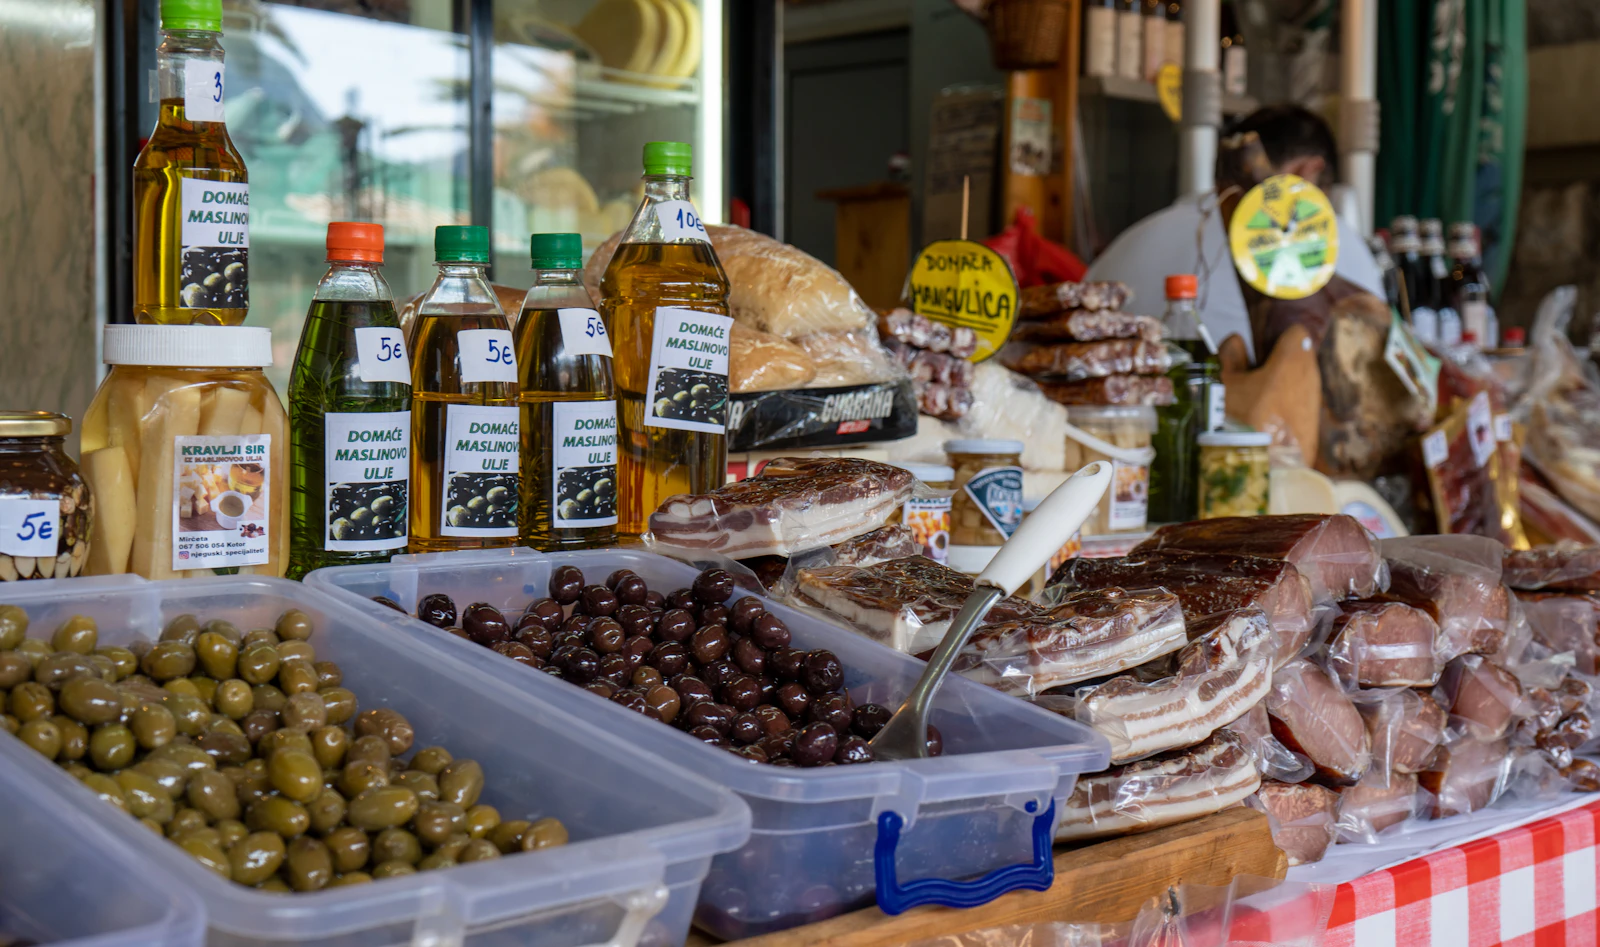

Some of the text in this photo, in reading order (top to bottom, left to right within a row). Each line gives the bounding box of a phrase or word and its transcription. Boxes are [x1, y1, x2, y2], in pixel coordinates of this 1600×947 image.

[213, 71, 223, 103] 3
[676, 208, 704, 232] 10€
[218, 231, 244, 245] ULJE
[586, 317, 605, 337] 5€
[678, 321, 725, 339] DOMAĆE
[377, 337, 402, 362] 5€
[485, 339, 513, 365] 5€
[665, 337, 728, 356] MASLINOVO
[688, 356, 713, 370] ULJE
[821, 390, 894, 423] GUARANA
[468, 421, 518, 435] DOMAĆE
[574, 415, 616, 430] DOMAĆE
[347, 427, 403, 443] DOMAĆE
[181, 444, 265, 456] KRAVLJI SIR
[334, 447, 407, 461] MASLINOVO
[481, 458, 509, 471] ULJE
[588, 452, 611, 464] ULJE
[363, 466, 394, 480] ULJE
[16, 511, 53, 541] 5€
[190, 548, 264, 558] njeguski_specijaliteti
